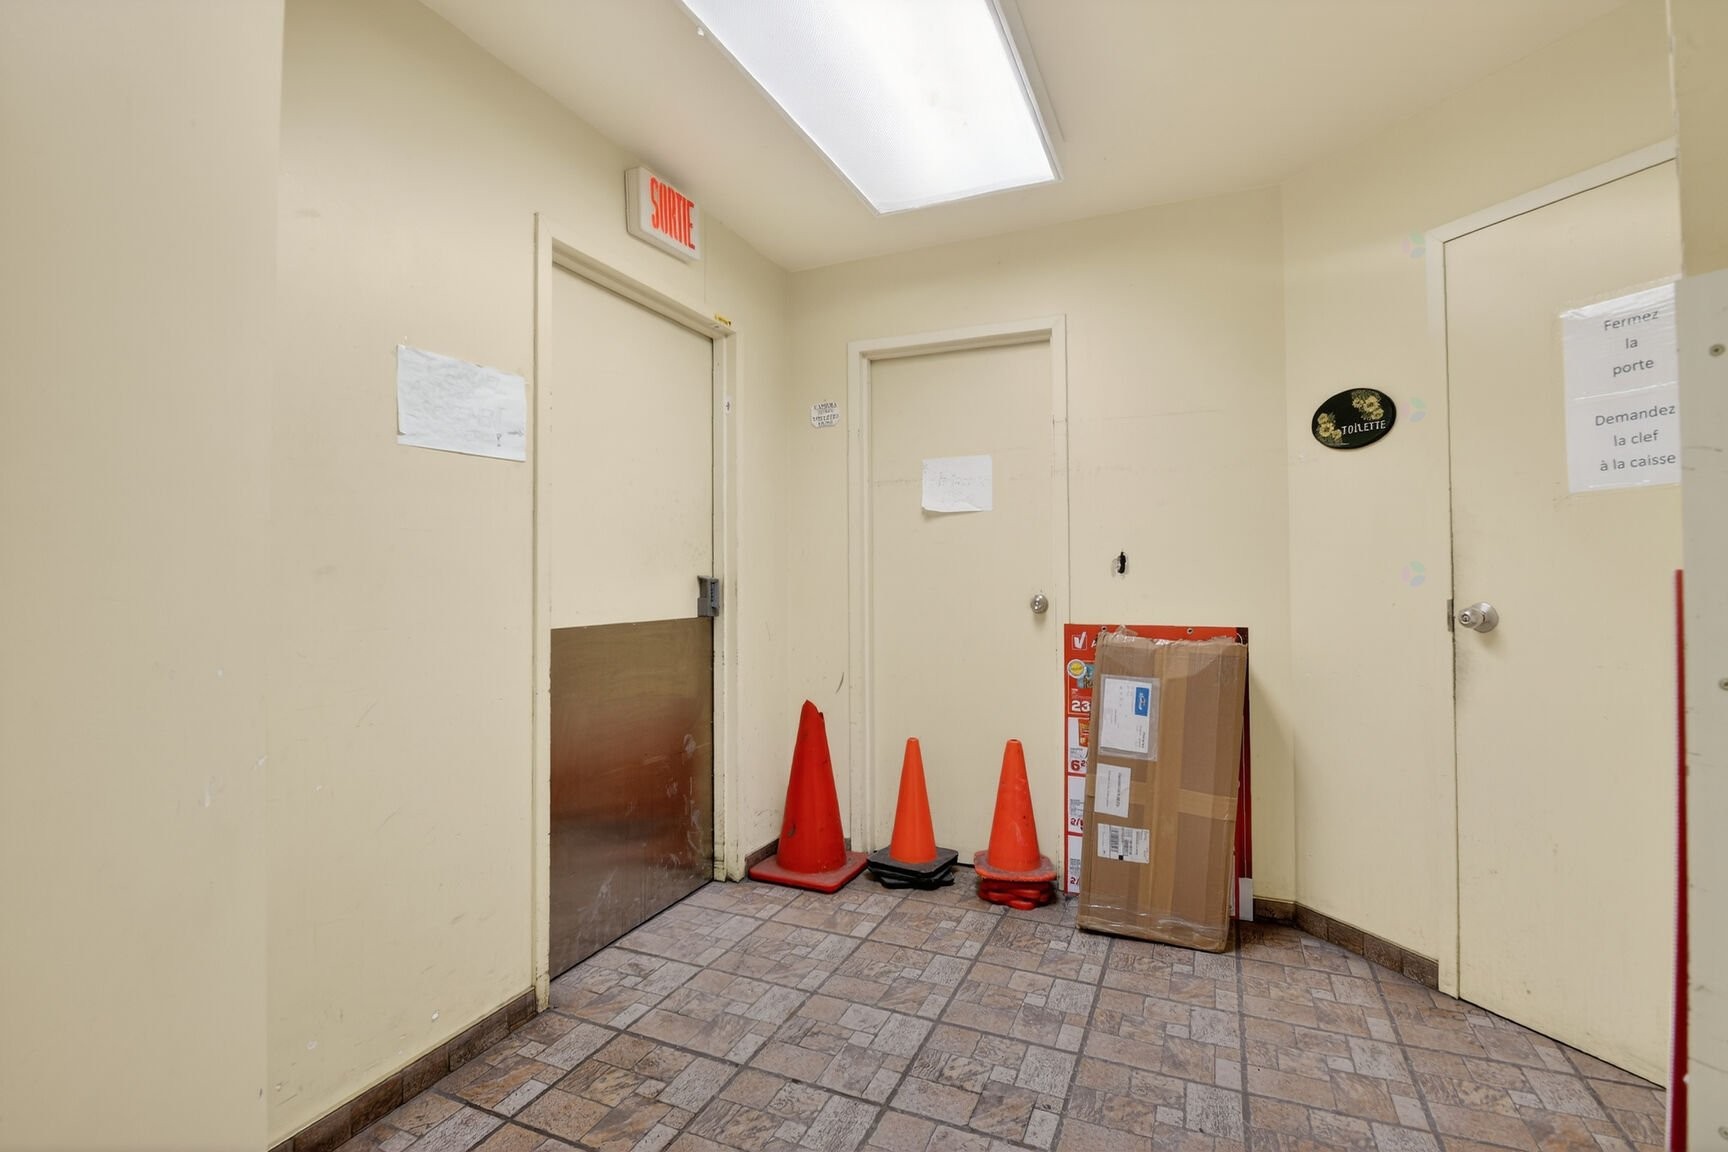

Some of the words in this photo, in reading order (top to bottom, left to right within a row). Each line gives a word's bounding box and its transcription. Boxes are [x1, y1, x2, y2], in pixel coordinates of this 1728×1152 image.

[650, 176, 695, 250] SORTIE
[1603, 310, 1660, 331] Fermez
[1625, 338, 1639, 349] la
[1613, 359, 1654, 377] porte
[1595, 405, 1676, 426] Demandez
[1341, 420, 1386, 435] TOILETTE
[1613, 435, 1626, 447] la
[1631, 429, 1659, 444] clef
[1600, 460, 1609, 471] à
[1613, 458, 1625, 470] la
[1630, 454, 1676, 468] caisse
